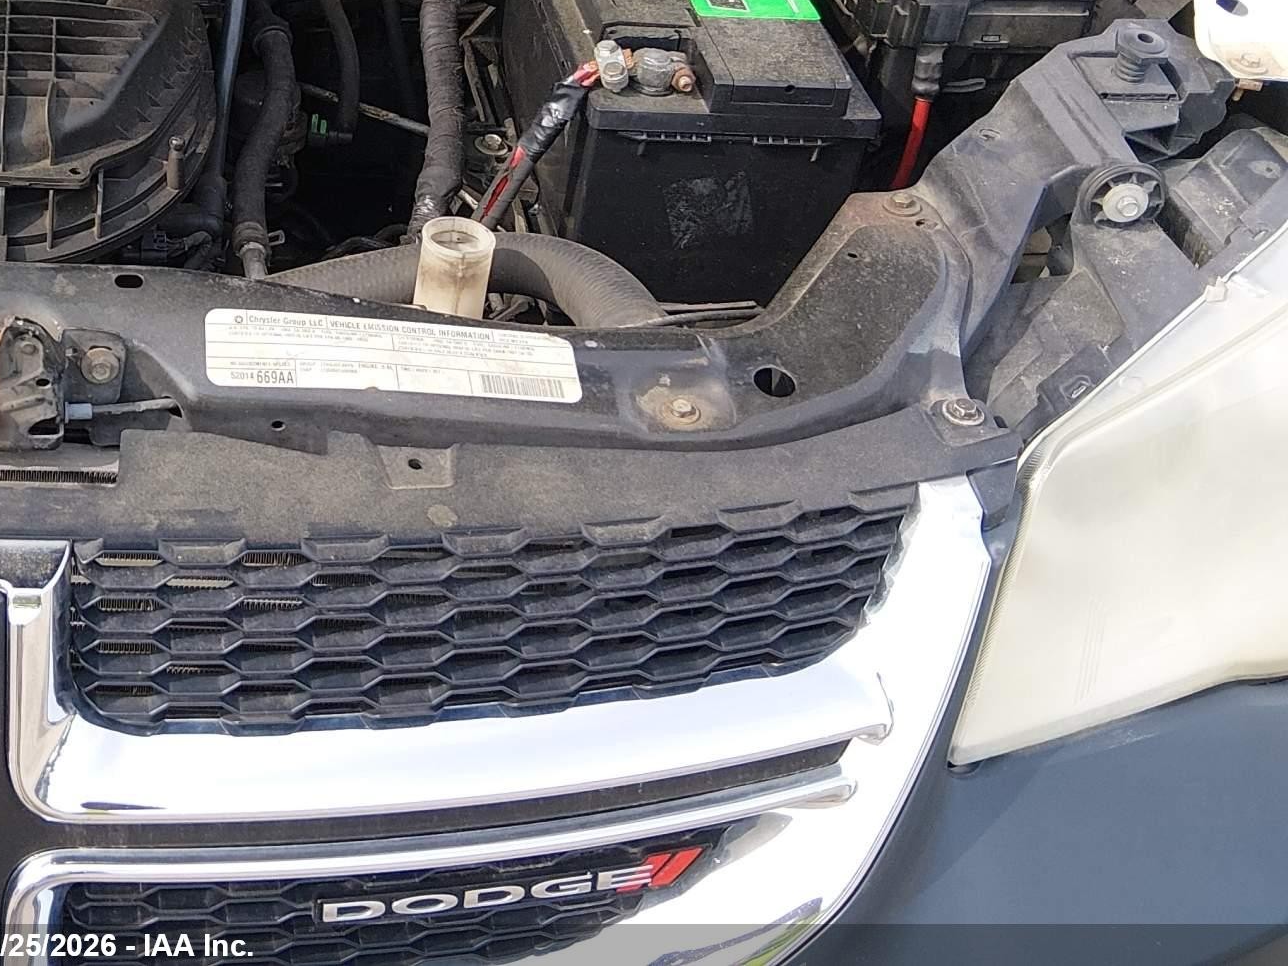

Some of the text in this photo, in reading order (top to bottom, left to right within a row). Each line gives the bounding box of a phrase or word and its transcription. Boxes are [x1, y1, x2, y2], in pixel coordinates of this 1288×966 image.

[248, 315, 324, 327] Chrysler Group LLC
[330, 320, 361, 330] VEHICLE
[363, 323, 400, 333] EMISSION
[401, 327, 436, 336] CONTROL
[438, 330, 490, 340] INFORMATION
[256, 371, 294, 384] 669AA
[322, 863, 654, 923] DODGE
